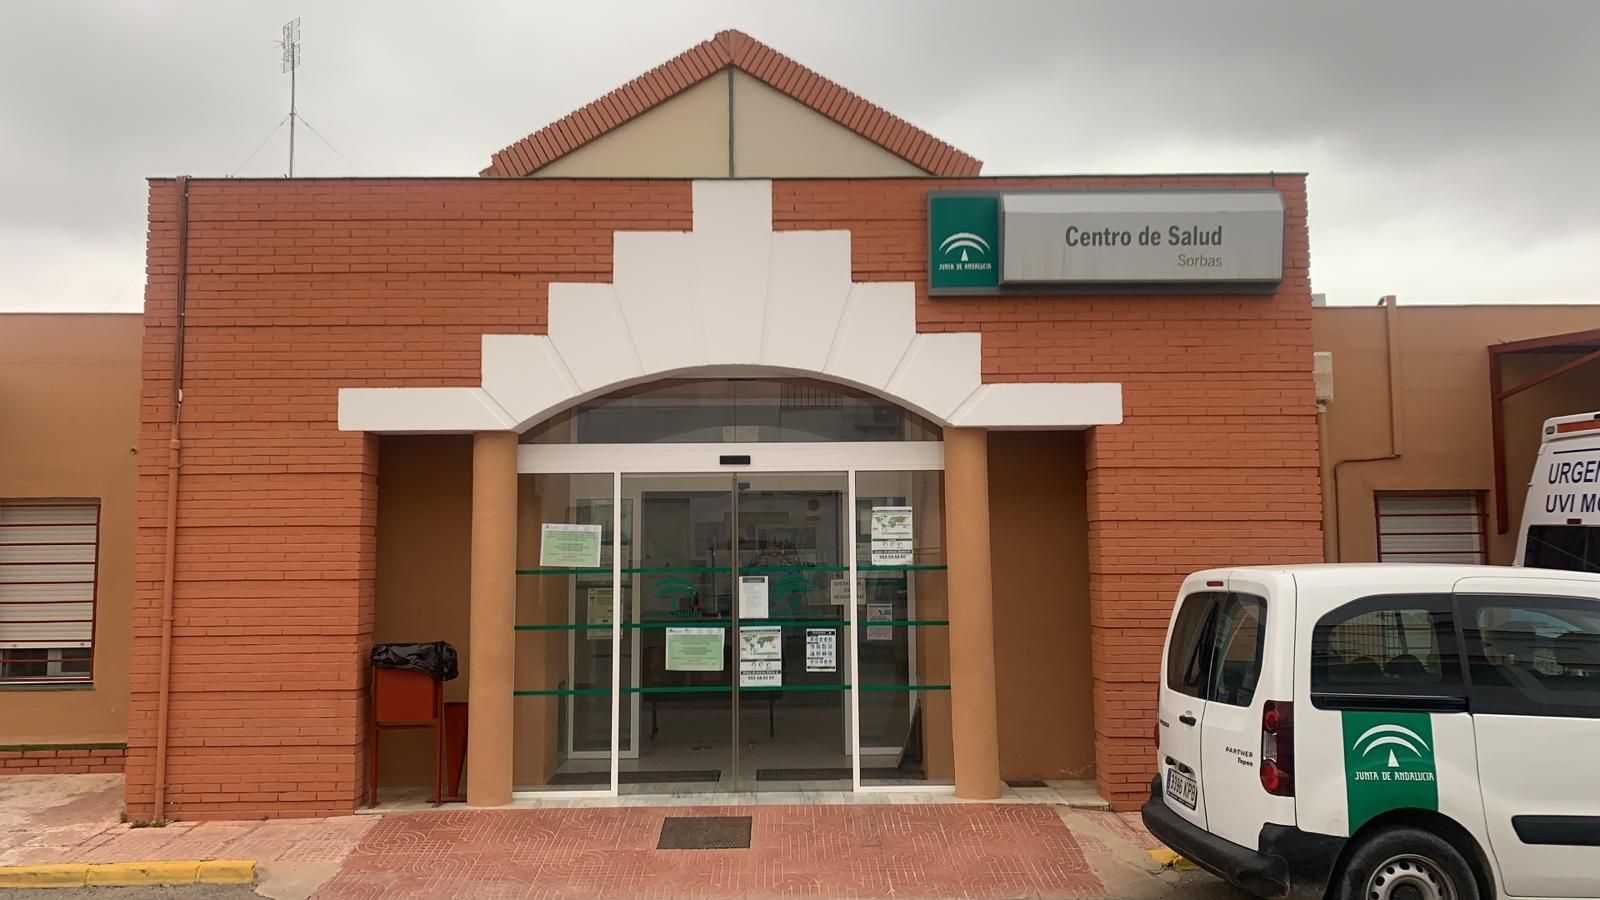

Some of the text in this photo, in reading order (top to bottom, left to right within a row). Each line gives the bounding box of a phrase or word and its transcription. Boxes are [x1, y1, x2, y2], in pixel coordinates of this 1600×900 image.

[1065, 225, 1222, 247] Centro de Salud
[1177, 253, 1223, 267] Sorbas
[1545, 493, 1600, 513] UVI M
[1225, 746, 1254, 758] PARTNER
[1354, 771, 1435, 782] JUNTA DE ANDALUCIA
